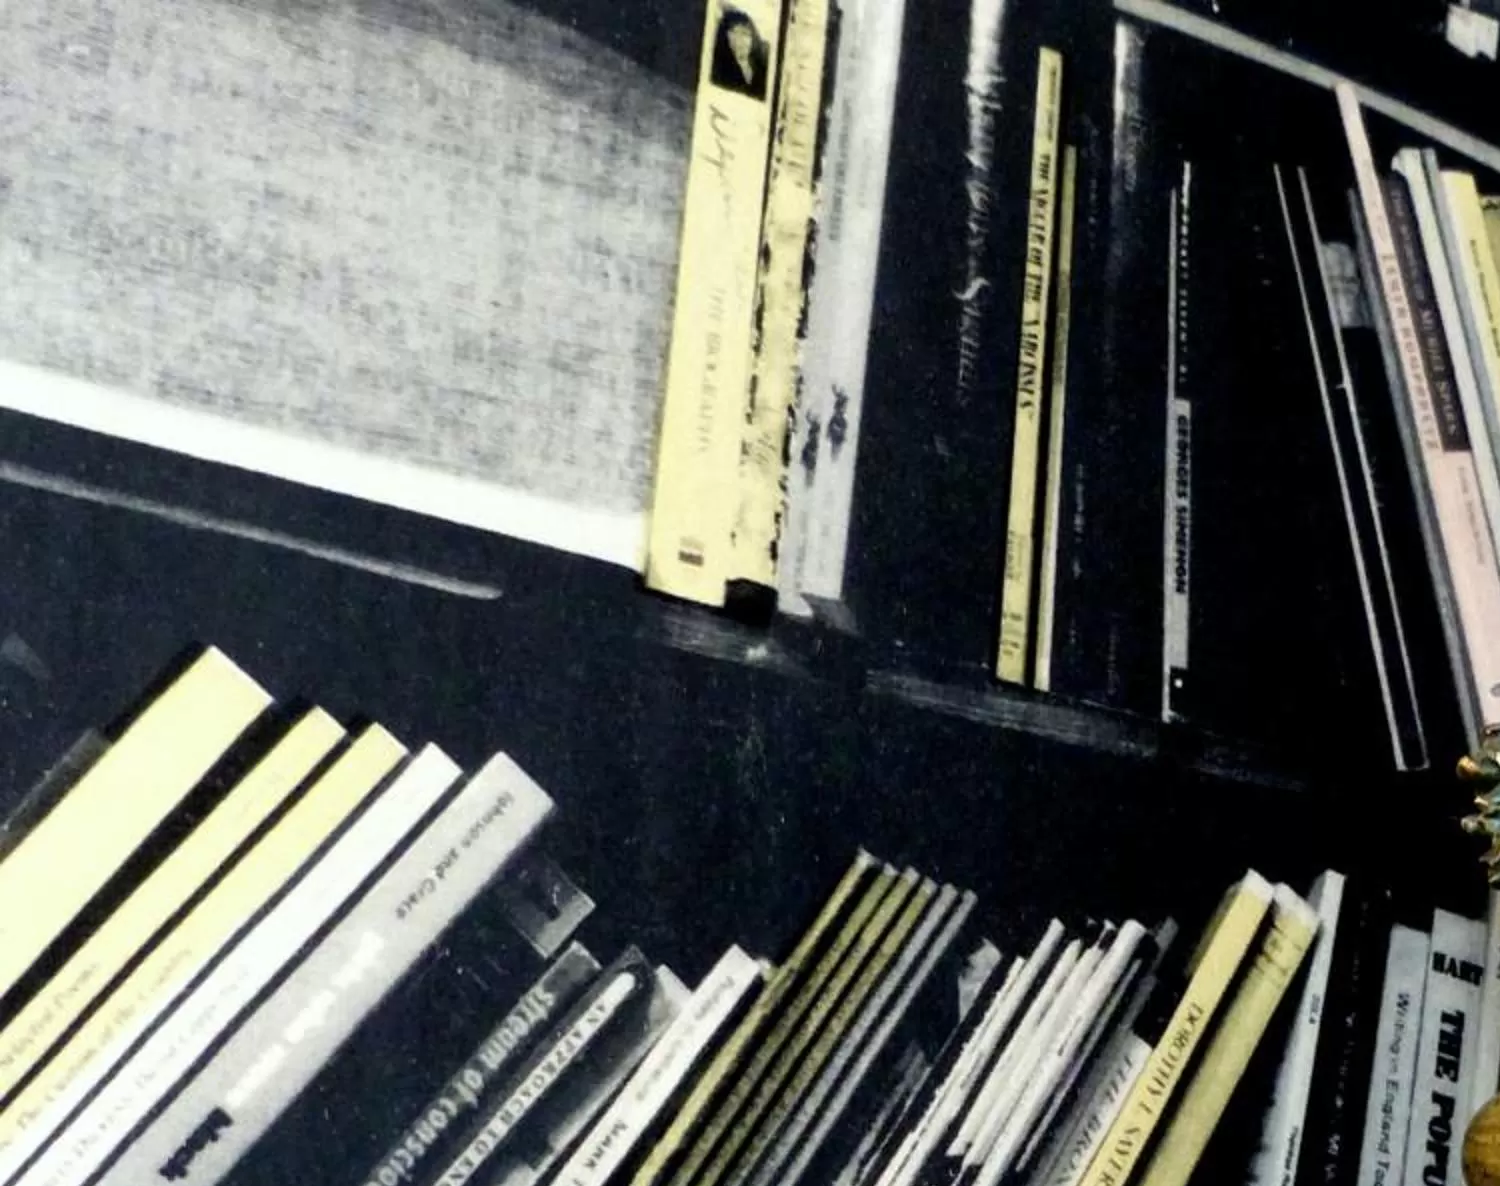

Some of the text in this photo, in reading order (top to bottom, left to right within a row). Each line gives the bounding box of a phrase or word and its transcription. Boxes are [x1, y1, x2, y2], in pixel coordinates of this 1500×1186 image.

[1171, 414, 1192, 594] GEORGES SIMENON
[473, 980, 558, 1071] stream
[581, 998, 609, 1029] AN
[1142, 1001, 1207, 1099] DOROTHY
[1433, 1008, 1466, 1082] THE
[447, 1062, 493, 1108] of
[496, 1026, 586, 1126] APPROACH
[471, 1127, 499, 1156] TO
[581, 1116, 628, 1173] MARK
[1375, 1079, 1400, 1153] England
